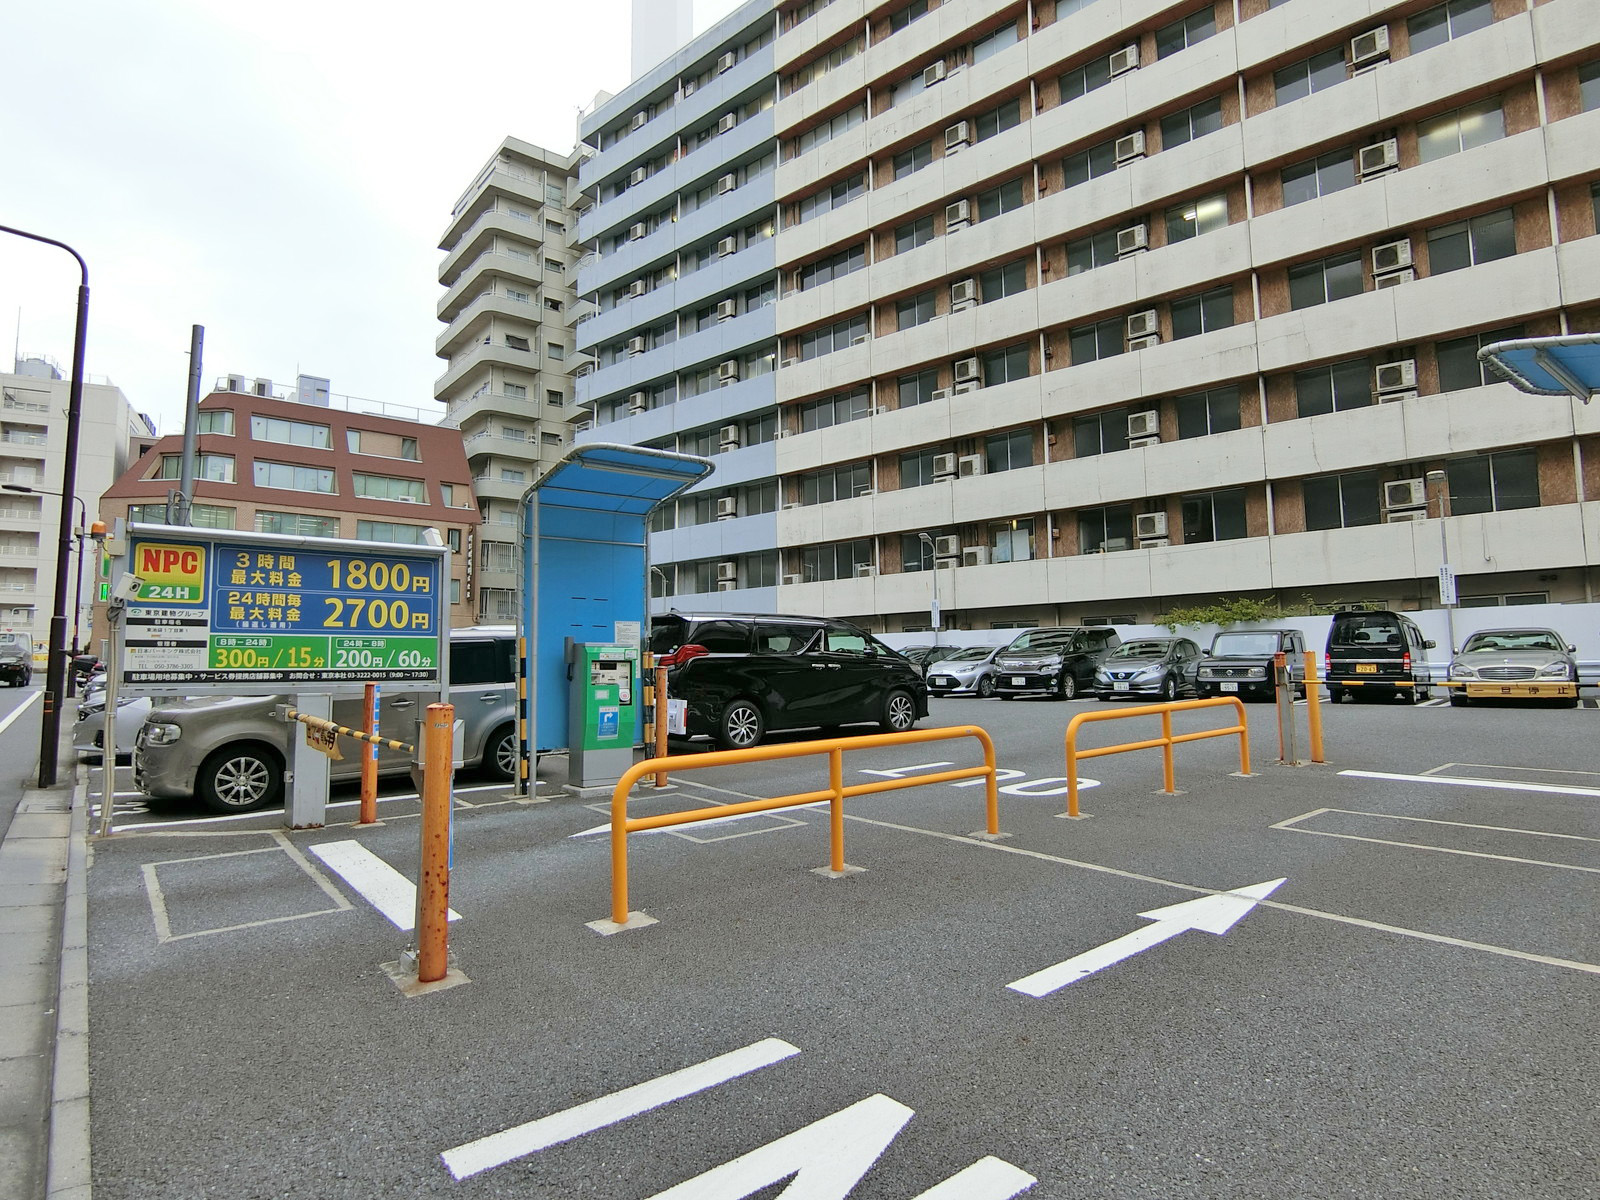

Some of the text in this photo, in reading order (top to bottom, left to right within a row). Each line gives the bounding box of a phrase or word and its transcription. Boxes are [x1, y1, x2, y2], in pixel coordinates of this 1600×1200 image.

[142, 548, 198, 575] NPC
[236, 552, 296, 571] 3時間
[230, 570, 303, 587] 最大料金
[327, 559, 431, 593] 1800円
[148, 585, 190, 599] 24H
[228, 591, 302, 608] 24時間毎
[145, 609, 205, 618] 東京建物グループ
[229, 606, 302, 622] 最大料金
[323, 597, 430, 629] 2700円
[1473, 686, 1569, 695] 一旦停止
